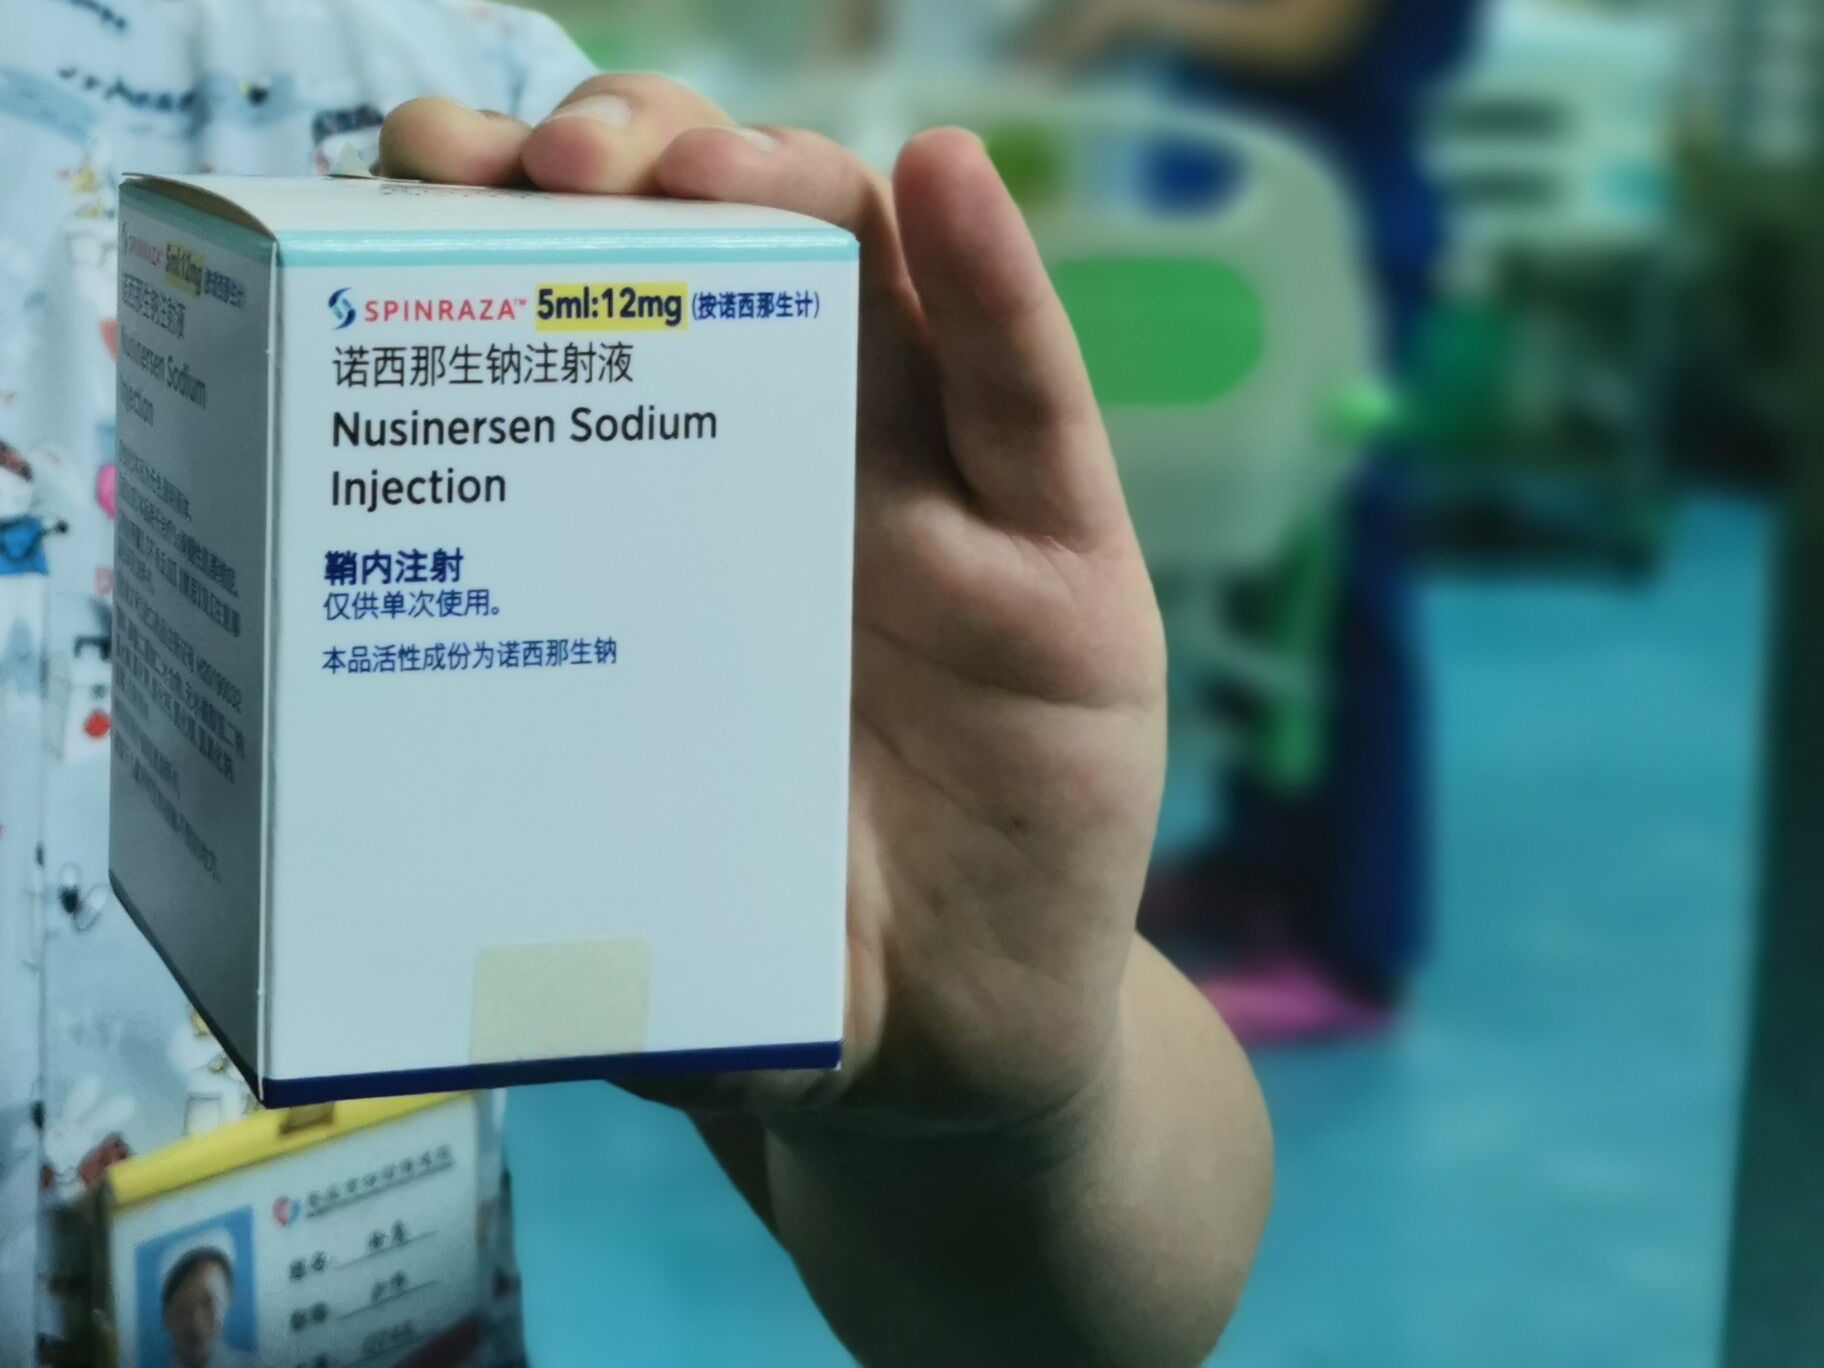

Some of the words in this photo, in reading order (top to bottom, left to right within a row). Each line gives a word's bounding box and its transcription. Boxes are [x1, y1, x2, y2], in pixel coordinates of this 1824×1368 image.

[537, 286, 682, 327] 5ml:12mg
[692, 291, 820, 320] (按诺西那生计)
[332, 341, 634, 388] 诺西那生钠注射液
[332, 409, 555, 448] Nusinersen
[570, 404, 717, 443] Sodium
[332, 467, 506, 513] Injection
[324, 547, 464, 586] 鞘内注射
[323, 588, 500, 621] 仅供单次使用。
[322, 636, 617, 675] 本品活性成份为诺西那生钠
